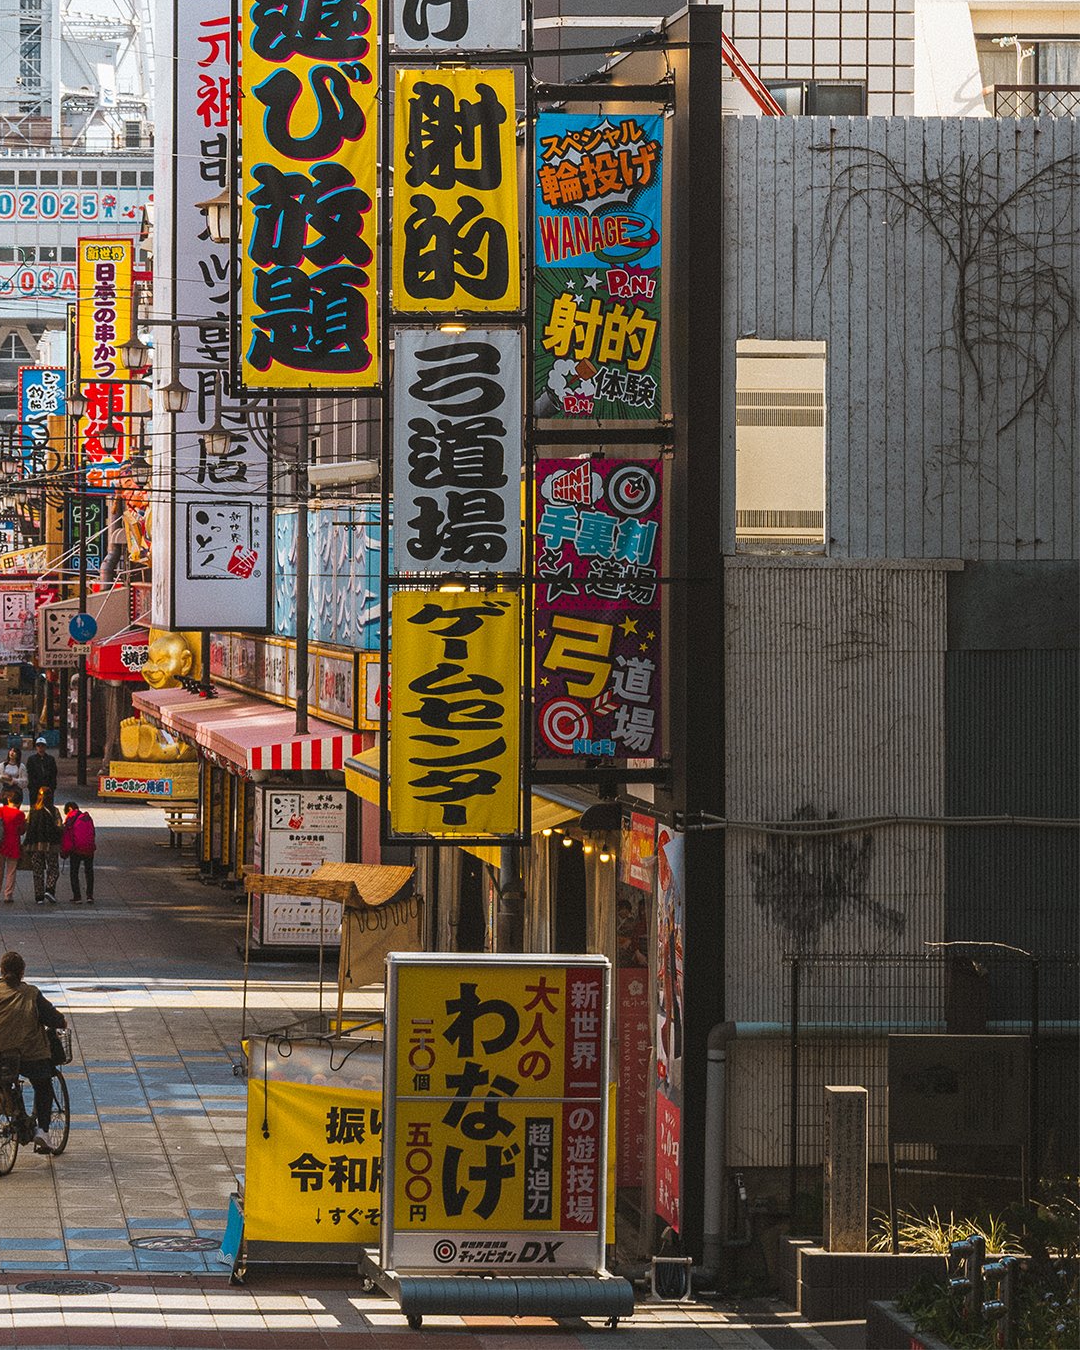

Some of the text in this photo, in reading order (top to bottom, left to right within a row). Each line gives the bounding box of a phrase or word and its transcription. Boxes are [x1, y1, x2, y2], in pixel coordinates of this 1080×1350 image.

[541, 120, 643, 160] スペシャル
[403, 81, 510, 300] 射的
[539, 142, 657, 206] 輪投げ
[20, 193, 97, 216] 2025
[86, 245, 125, 261] 新世界
[538, 216, 631, 264] WANAGE
[20, 270, 76, 293] OSA
[606, 269, 657, 298] PAN!
[93, 262, 116, 377] 日本一の串かつ
[542, 293, 657, 371] 射的
[563, 396, 594, 413] PAN!
[594, 367, 657, 409] 体験
[553, 483, 590, 504] NIN!
[554, 461, 590, 490] NIN!
[538, 504, 658, 565] 手裏剣
[585, 559, 657, 605] 道場
[543, 615, 655, 751] 弓 道場
[402, 600, 512, 826] ゲームセンター
[572, 738, 617, 757] NICE!
[105, 778, 146, 792] 日本一の串かつ
[518, 976, 560, 1081] 大人の
[442, 982, 521, 1220] わなげ
[566, 981, 599, 1224] 新世界一の遊技場
[326, 1106, 381, 1145] 振り
[405, 1122, 433, 1222] 五〇〇円
[528, 1124, 551, 1214] 超ド迫力
[328, 1207, 380, 1226] すぐそ
[459, 1250, 517, 1263] チャンピオン
[517, 1241, 565, 1263] DX
